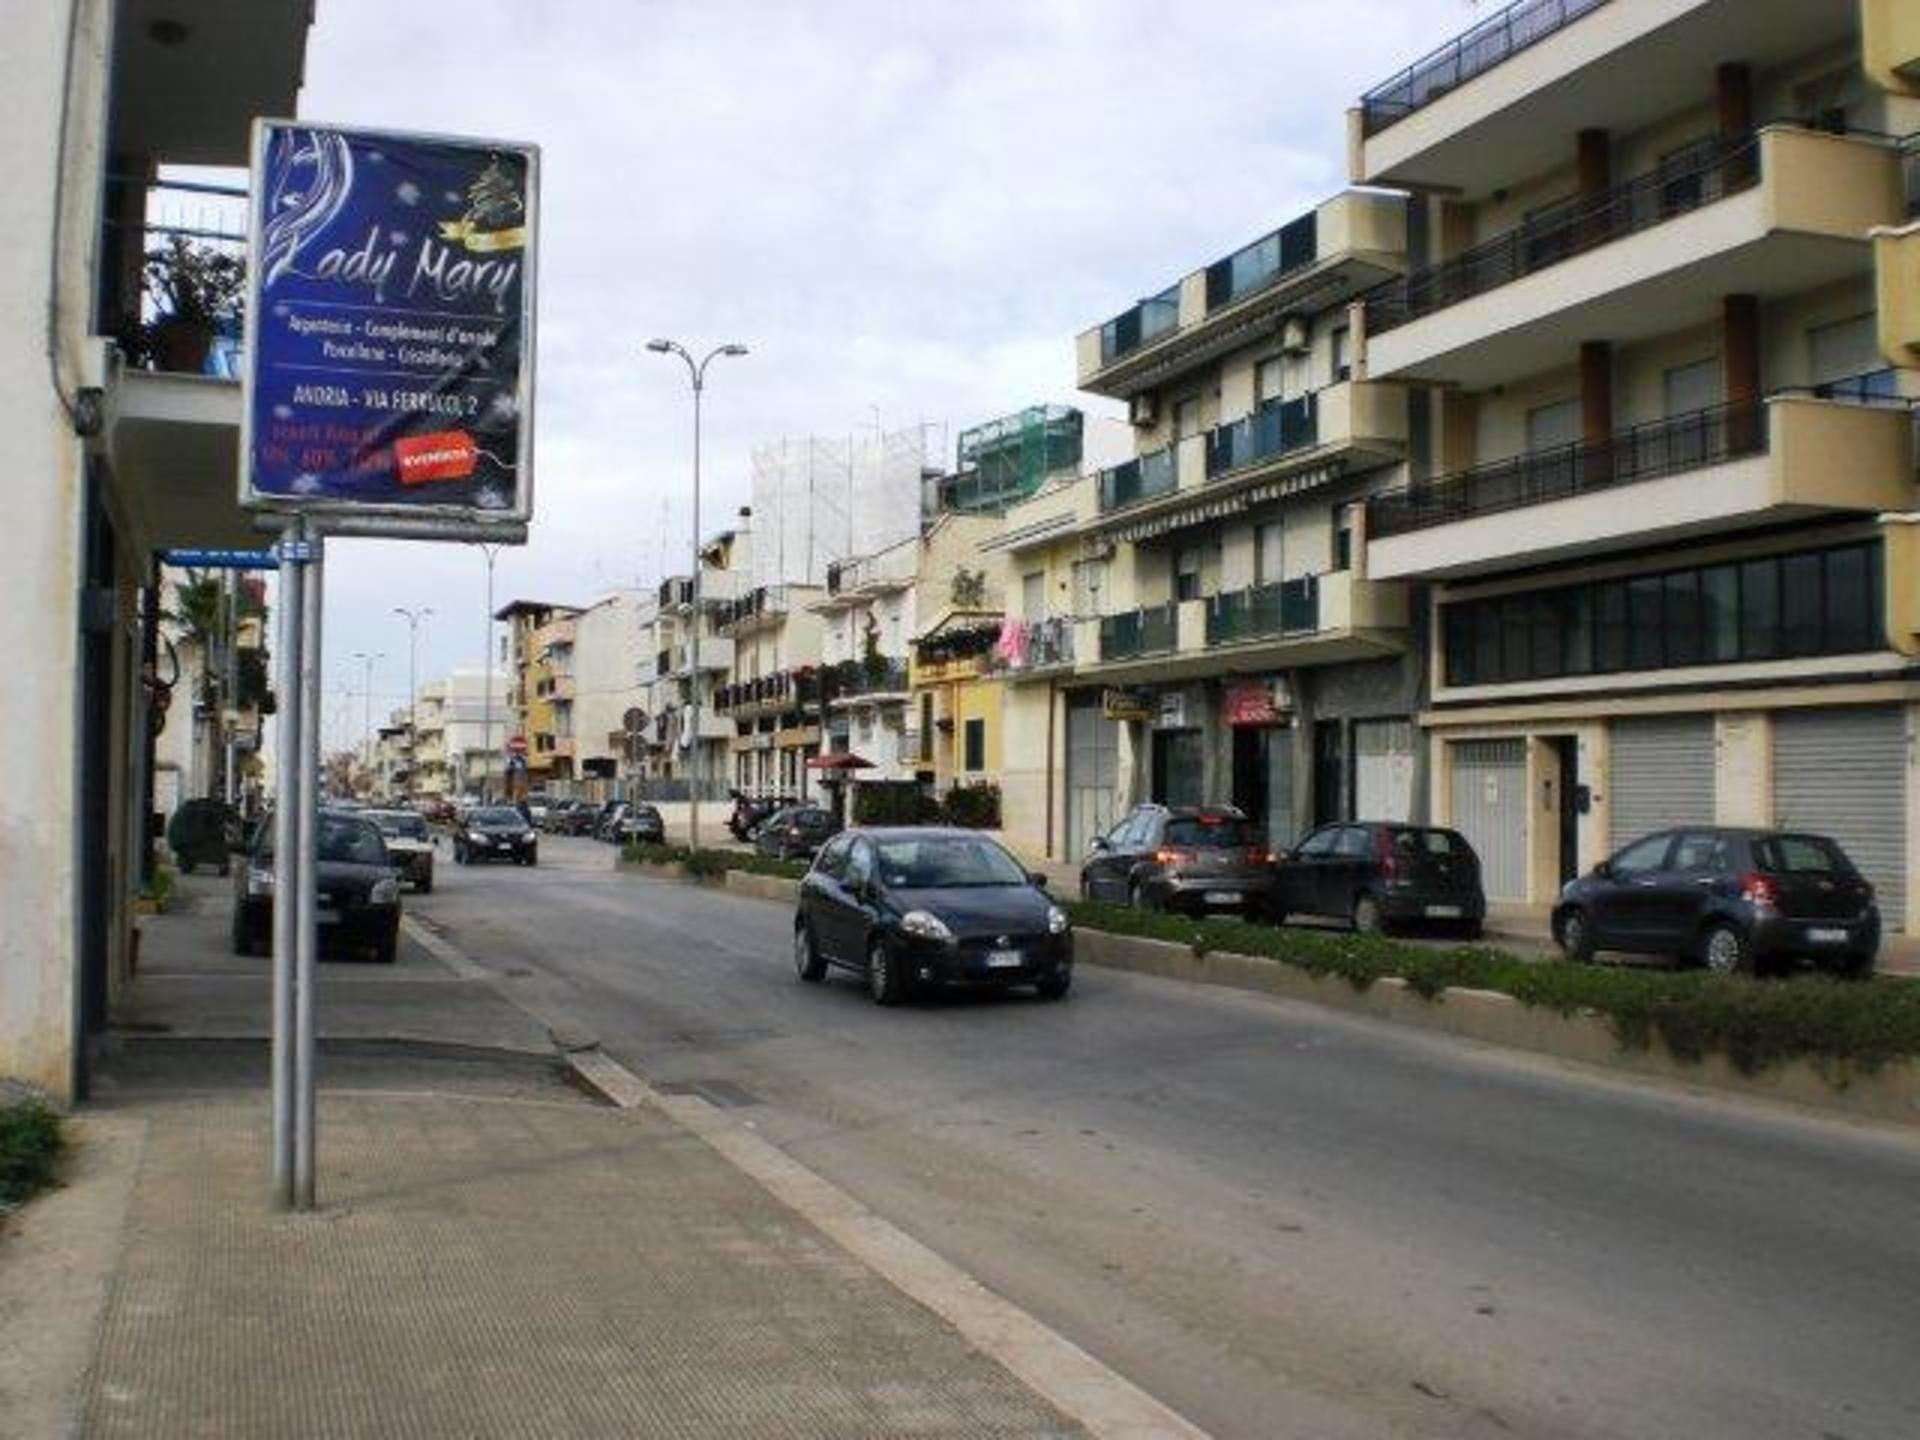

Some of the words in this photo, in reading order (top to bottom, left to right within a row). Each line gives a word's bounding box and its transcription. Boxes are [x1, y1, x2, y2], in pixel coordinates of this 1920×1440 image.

[263, 225, 396, 303] Lady
[406, 238, 517, 313] Mary
[293, 385, 350, 408] ANDRIA
[365, 389, 389, 408] VIA
